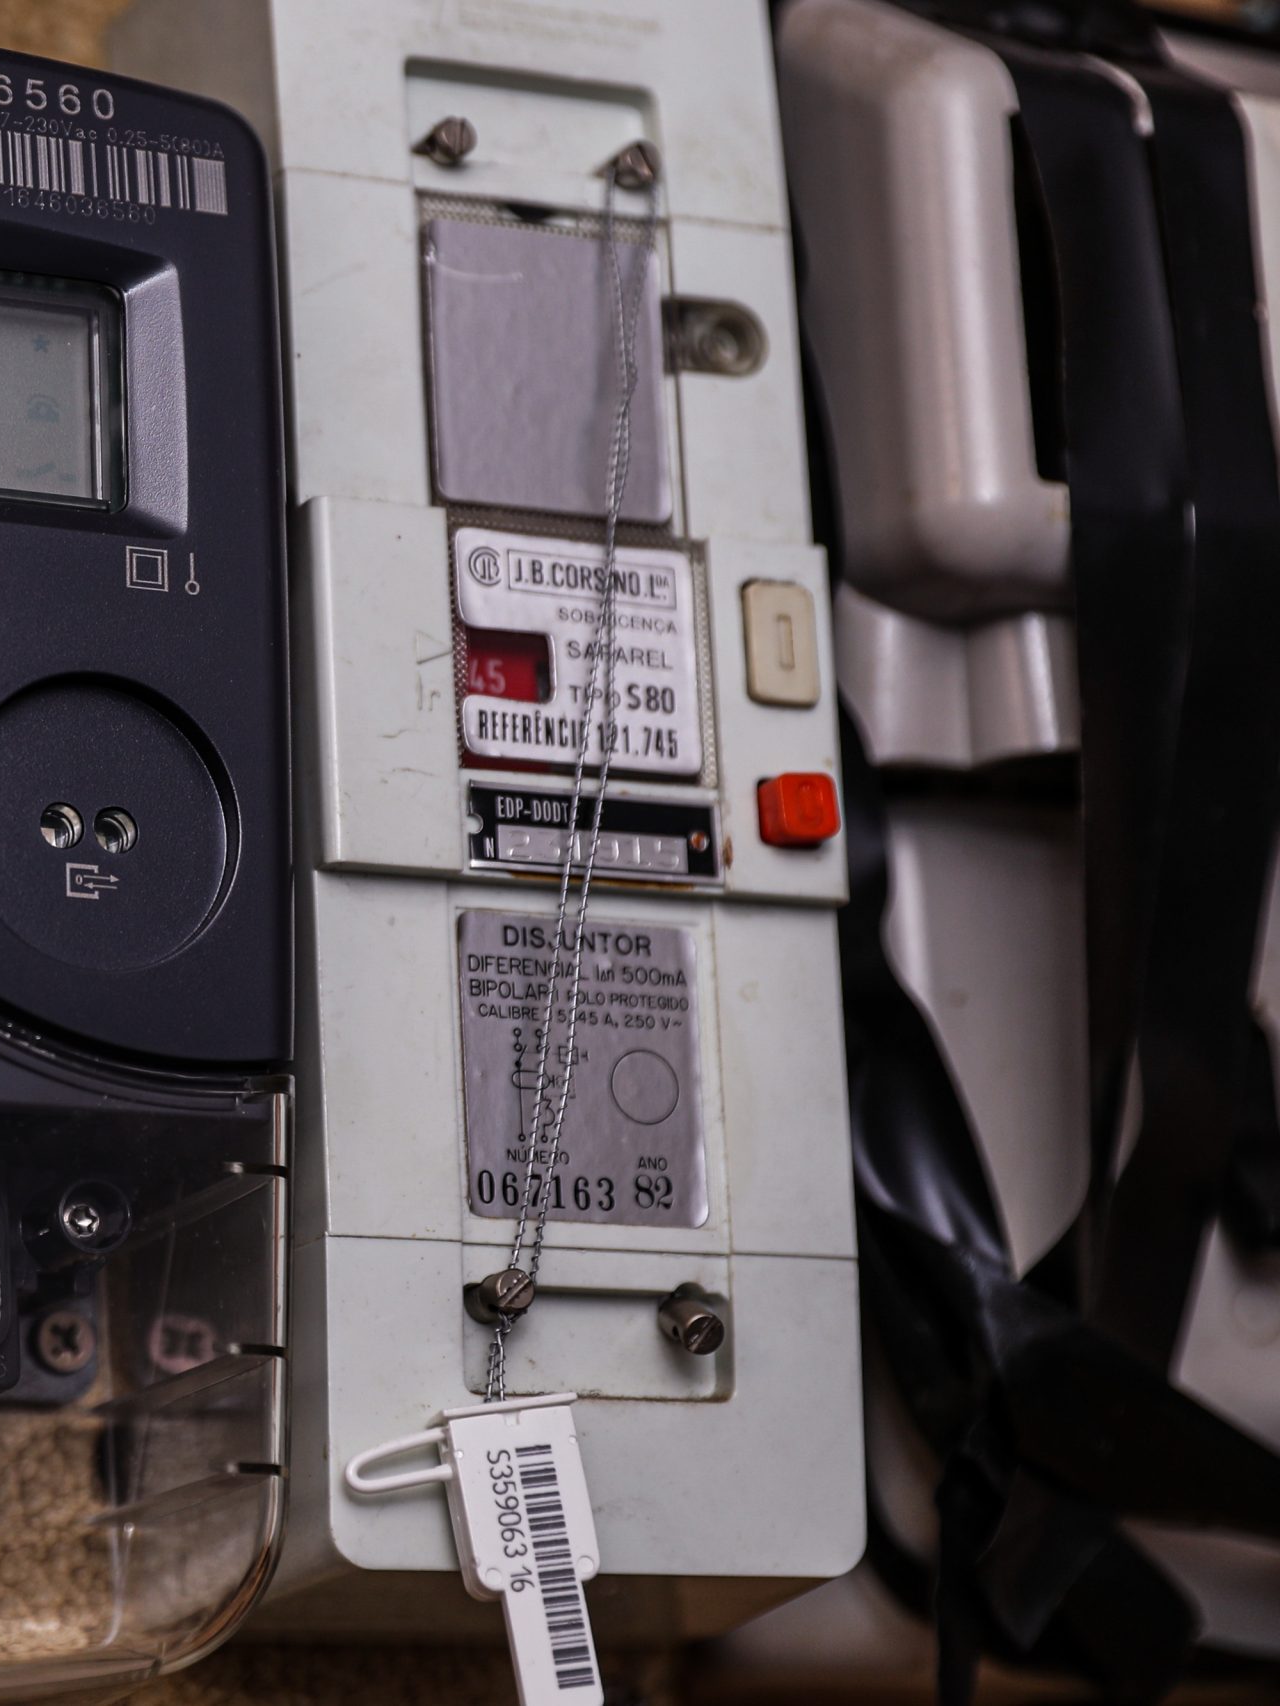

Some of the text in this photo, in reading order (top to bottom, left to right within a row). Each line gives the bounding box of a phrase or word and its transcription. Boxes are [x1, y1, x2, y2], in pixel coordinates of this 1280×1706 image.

[598, 612, 677, 636] CENÇA
[470, 658, 506, 695] 45
[622, 966, 687, 987] 500mA
[610, 993, 690, 1012] PROTEGIDO
[479, 1003, 539, 1021] CALIBRE
[624, 1014, 656, 1030] 250
[638, 1156, 668, 1172] ANO
[477, 1170, 674, 1211] 067163 82
[486, 1449, 529, 1559] S359063
